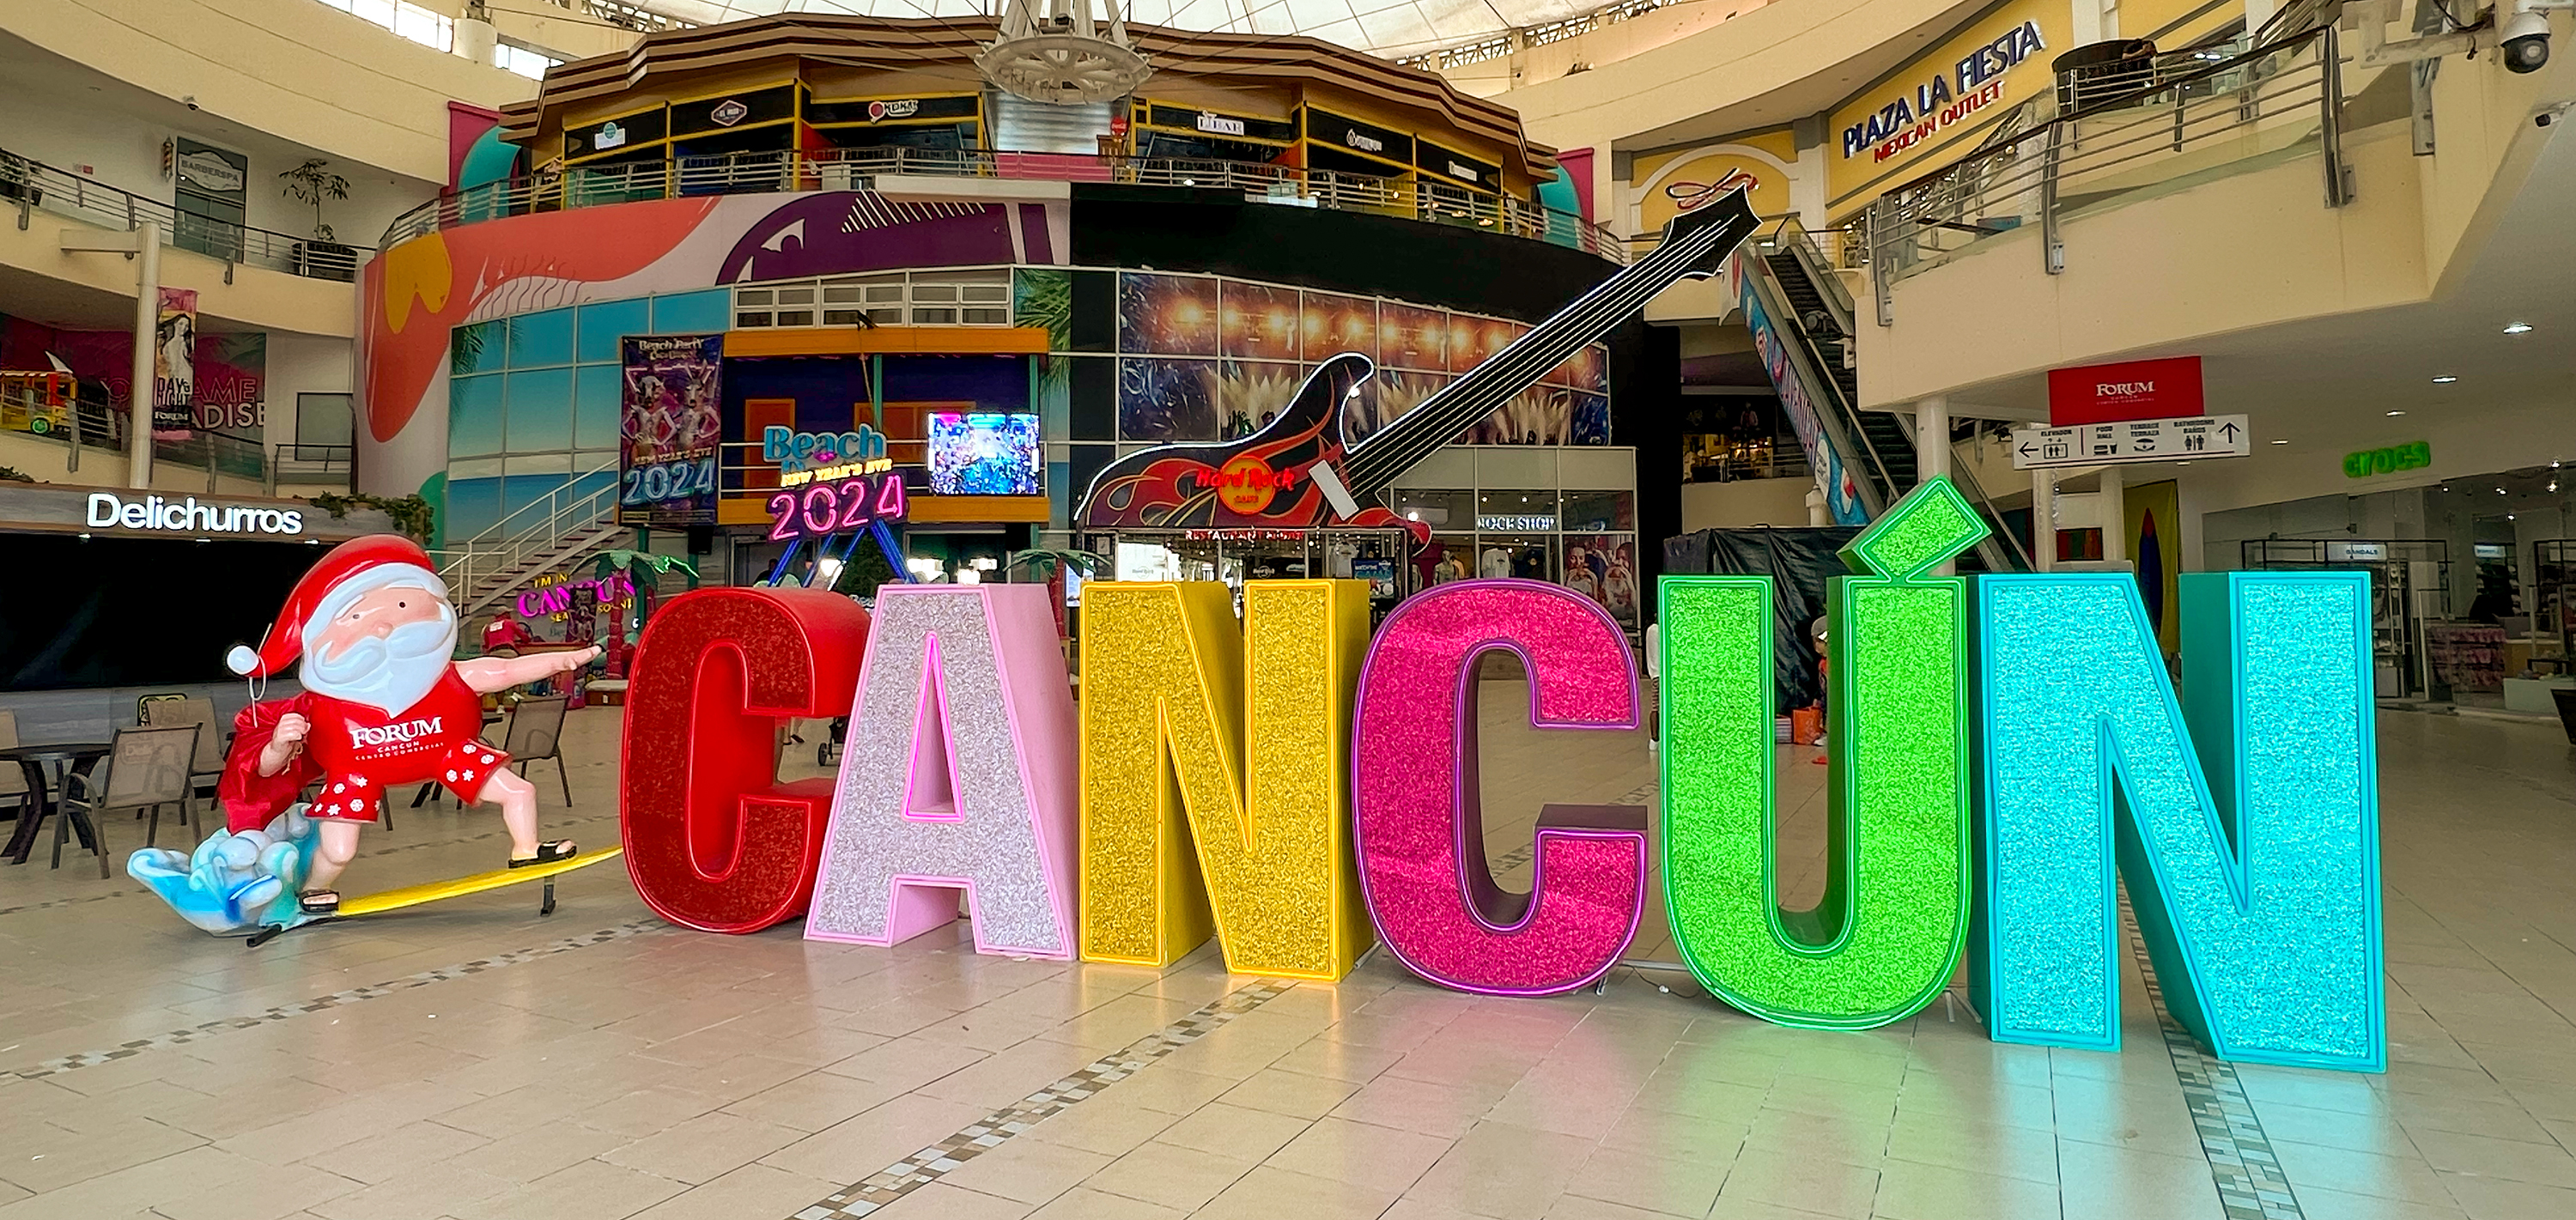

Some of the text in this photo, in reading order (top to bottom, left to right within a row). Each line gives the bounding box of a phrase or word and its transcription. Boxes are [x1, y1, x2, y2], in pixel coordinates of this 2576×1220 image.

[1844, 20, 2046, 159] PLAZA LA FIESTA
[1874, 81, 2005, 163] MEXICAN OUTLET
[181, 160, 240, 182] BARBERSPA
[2096, 380, 2156, 397] FORUM
[763, 423, 887, 462] Beach
[2343, 441, 2431, 477] crocs
[623, 459, 714, 505] 2024
[781, 470, 814, 488] NEW
[815, 464, 863, 482] YEAR'S
[865, 458, 893, 475] EVE
[1195, 467, 1295, 492] Hard Rock
[86, 493, 302, 535] Delichurros
[770, 475, 903, 540] 2024
[1477, 515, 1555, 530] ROCK SHOP
[1185, 529, 1263, 541] RESTAURANT
[534, 574, 569, 588] I'M IN
[351, 717, 444, 750] FORUM
[620, 475, 2389, 1075] CANCÚN
